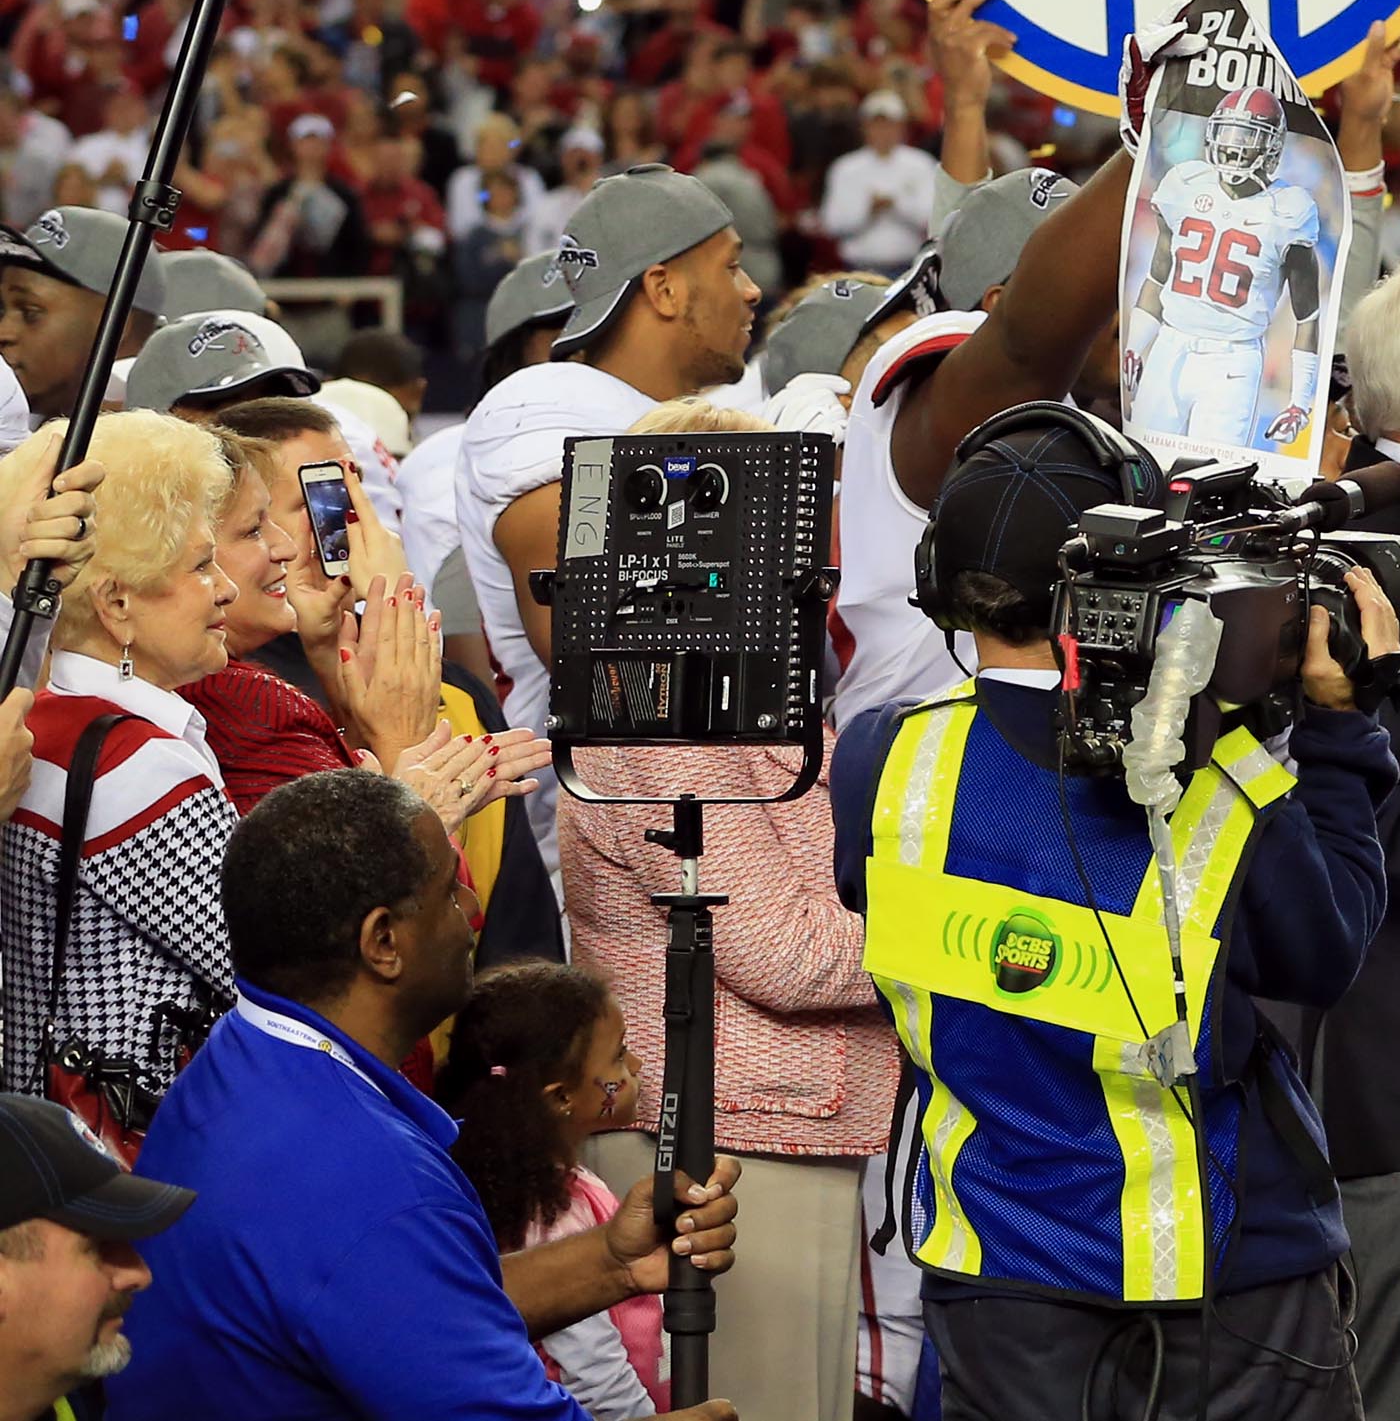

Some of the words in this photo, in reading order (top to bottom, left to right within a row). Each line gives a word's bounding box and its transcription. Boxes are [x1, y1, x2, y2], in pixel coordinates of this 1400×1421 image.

[1172, 217, 1262, 309] 26
[1178, 442, 1215, 456] CRIMSON
[667, 461, 690, 472] bexel
[574, 463, 604, 546] ENG
[666, 535, 684, 543] LITE
[619, 554, 648, 568] LP-1
[652, 557, 660, 568] x
[664, 554, 670, 568] 1
[618, 569, 669, 581] BI-FOCUS
[656, 663, 667, 719] HYTRON
[1017, 935, 1053, 955] CBS
[995, 944, 1050, 970] SPORTS
[266, 1020, 317, 1043] SOUTHEASTERN
[657, 1092, 679, 1172] GITZO
